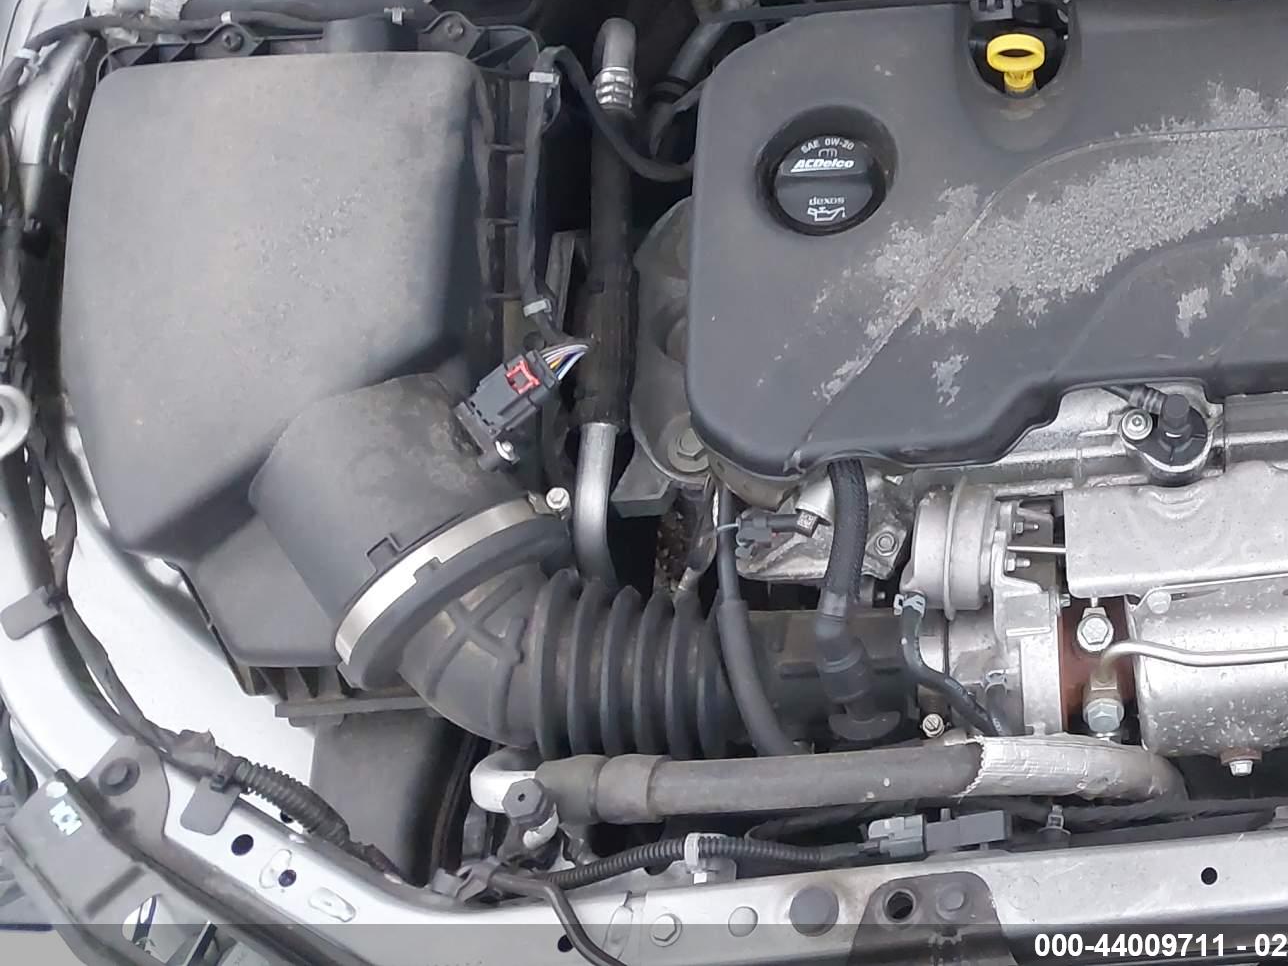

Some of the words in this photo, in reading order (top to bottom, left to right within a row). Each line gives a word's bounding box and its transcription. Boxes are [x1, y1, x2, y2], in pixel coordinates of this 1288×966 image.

[801, 139, 820, 153] SAE
[824, 137, 855, 151] 0W-20
[791, 158, 855, 172] ACDelco
